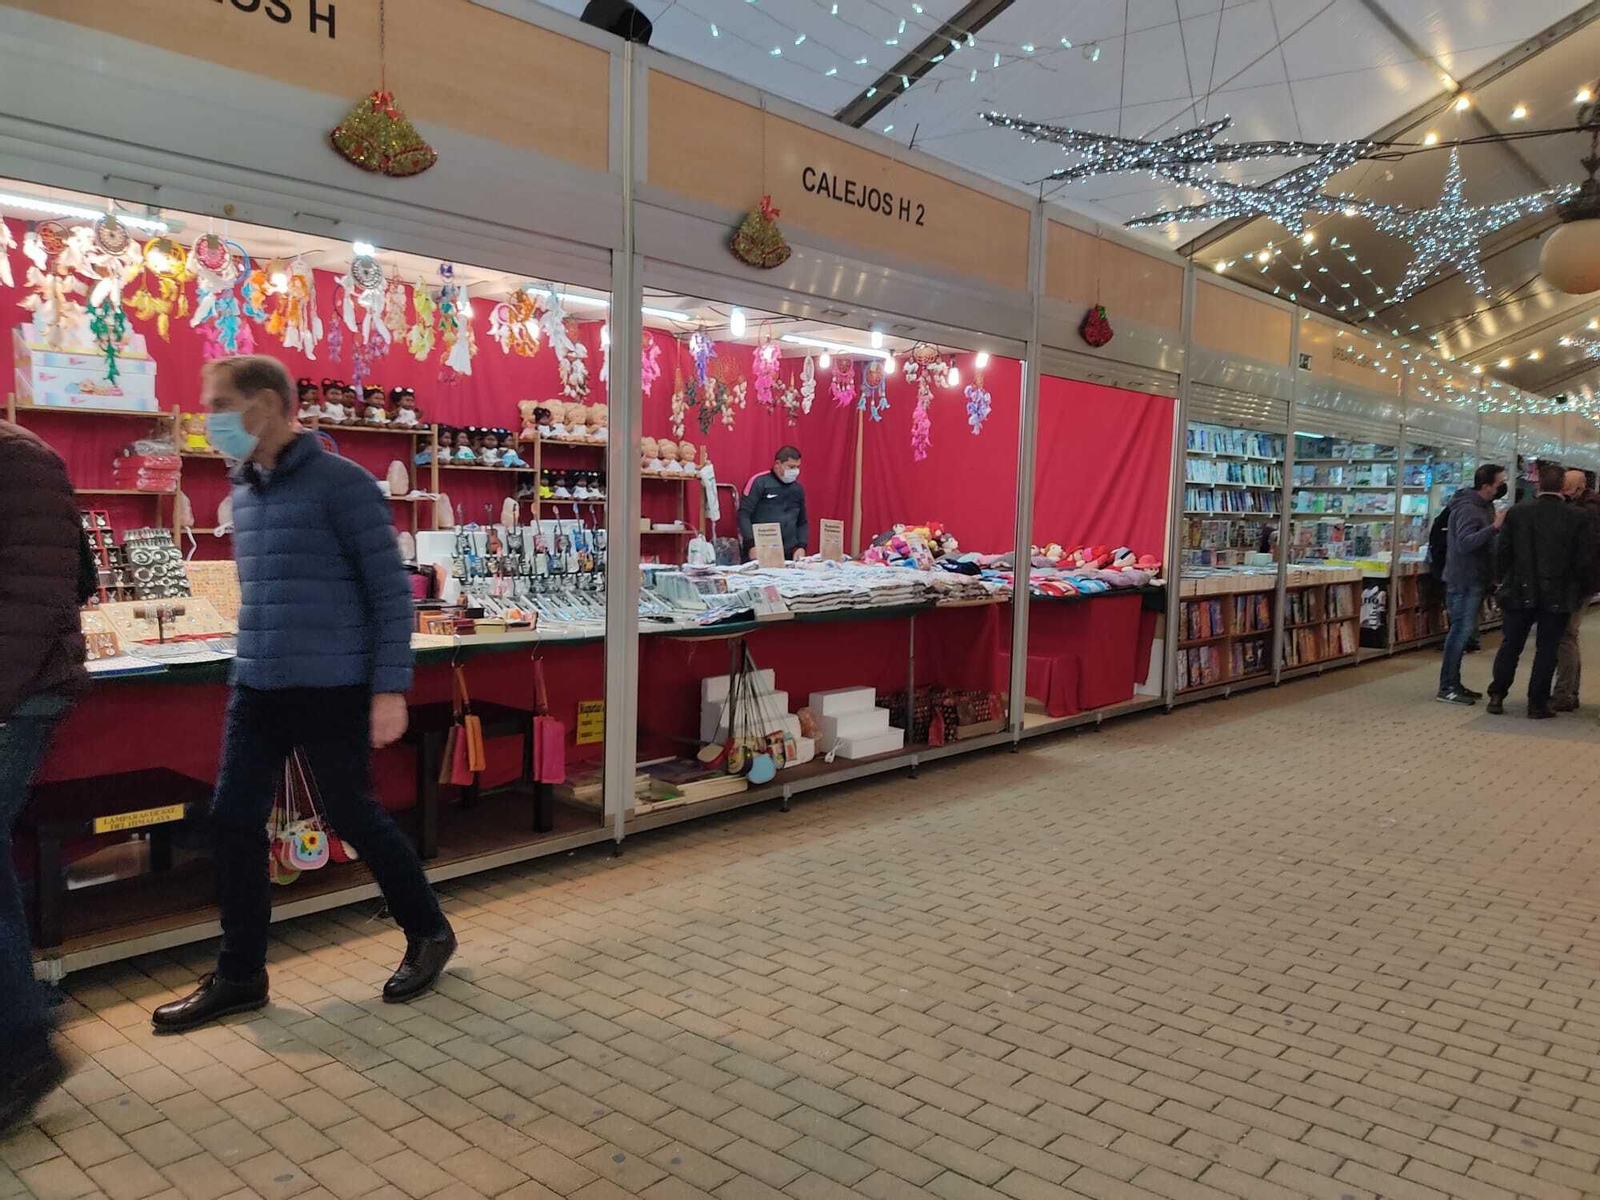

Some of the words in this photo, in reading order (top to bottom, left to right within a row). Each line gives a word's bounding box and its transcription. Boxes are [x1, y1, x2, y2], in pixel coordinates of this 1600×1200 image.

[310, 0, 335, 39] H
[802, 166, 893, 216] CALEJOS
[898, 197, 911, 222] H
[915, 204, 925, 226] 2
